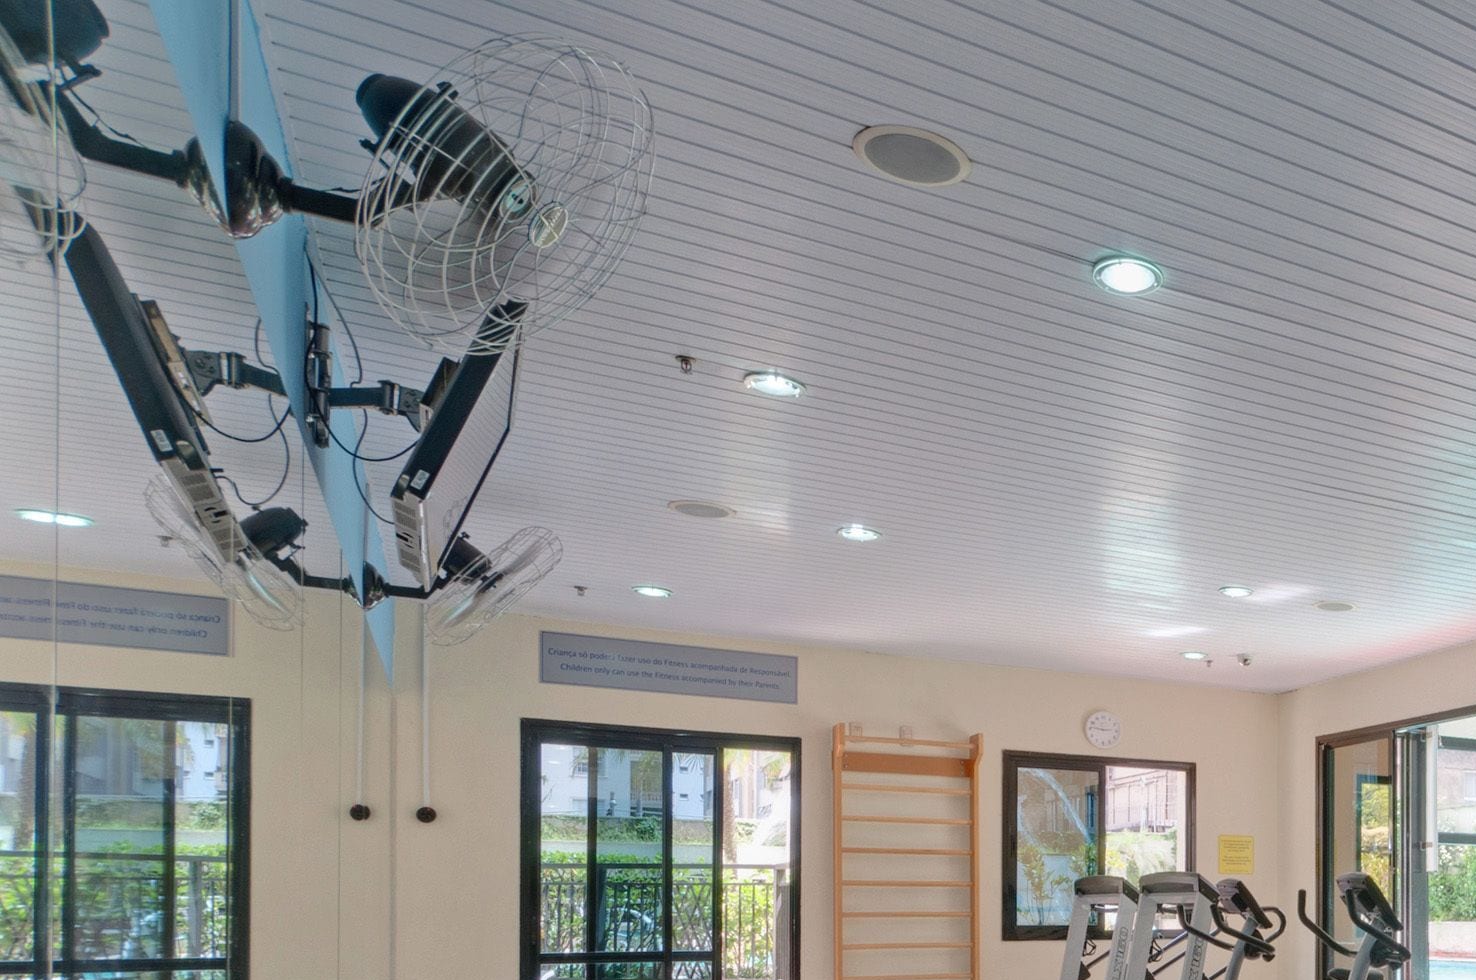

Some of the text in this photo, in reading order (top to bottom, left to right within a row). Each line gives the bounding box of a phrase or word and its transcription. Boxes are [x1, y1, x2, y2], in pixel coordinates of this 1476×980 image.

[548, 648, 577, 658] Criança
[579, 650, 588, 658] só
[560, 663, 593, 672] Children
[594, 666, 610, 675] only
